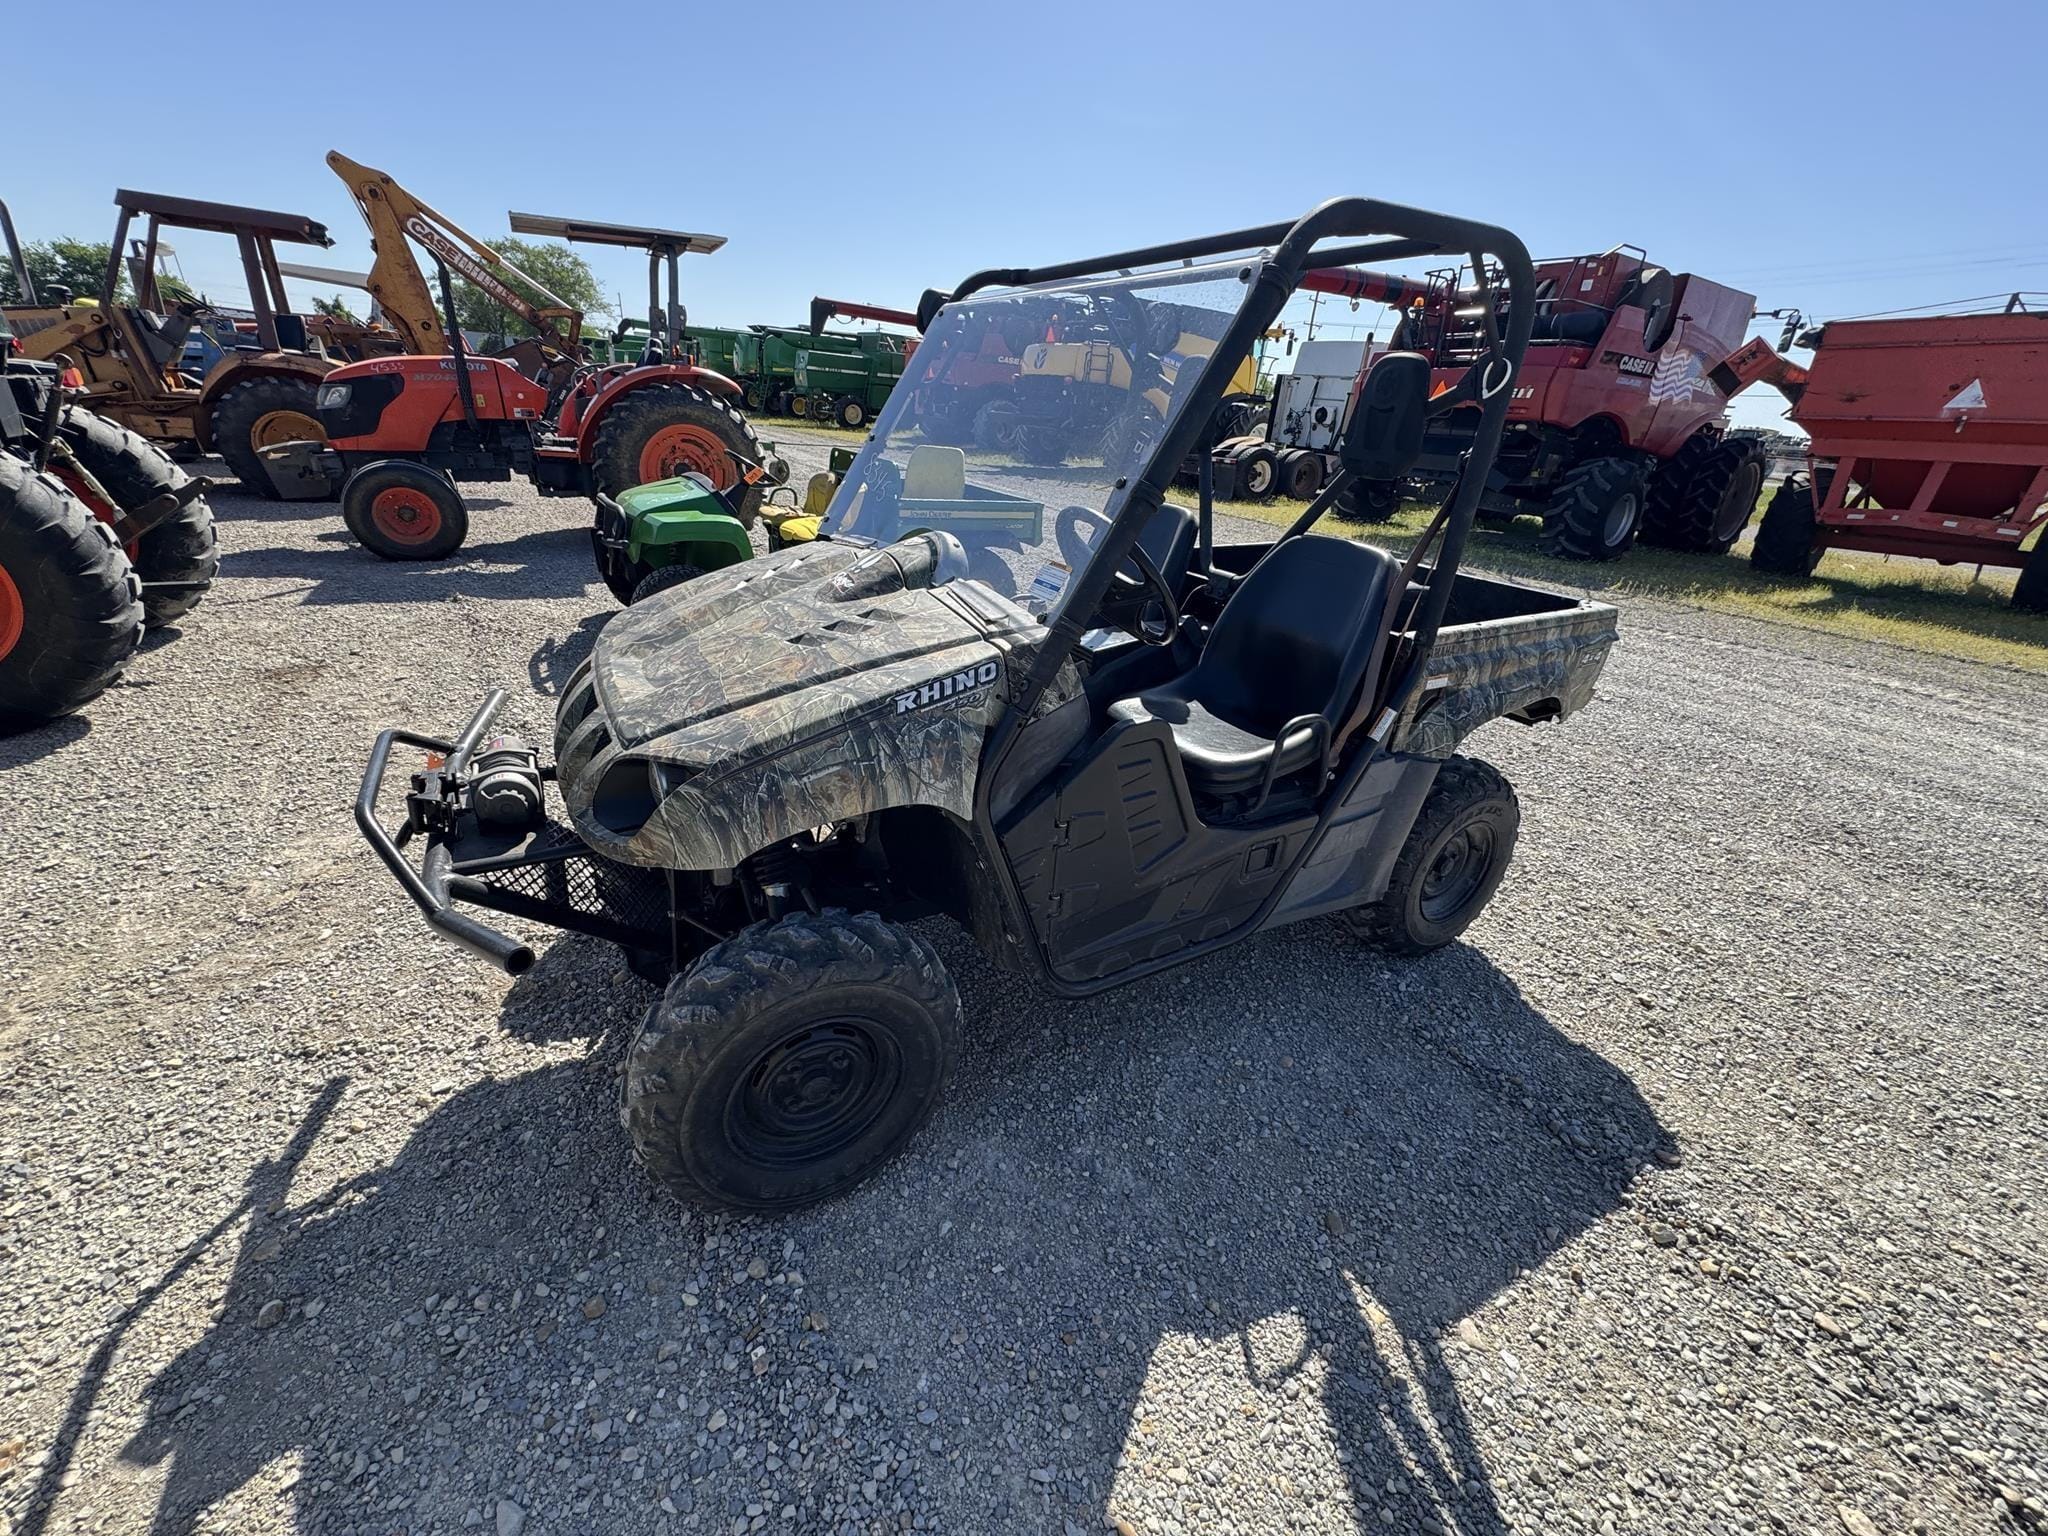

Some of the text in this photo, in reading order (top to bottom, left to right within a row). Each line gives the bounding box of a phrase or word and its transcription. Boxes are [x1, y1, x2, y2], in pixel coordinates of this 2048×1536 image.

[410, 220, 461, 263] CASE
[440, 361, 489, 371] KUOTA
[894, 660, 998, 715] RHINO
